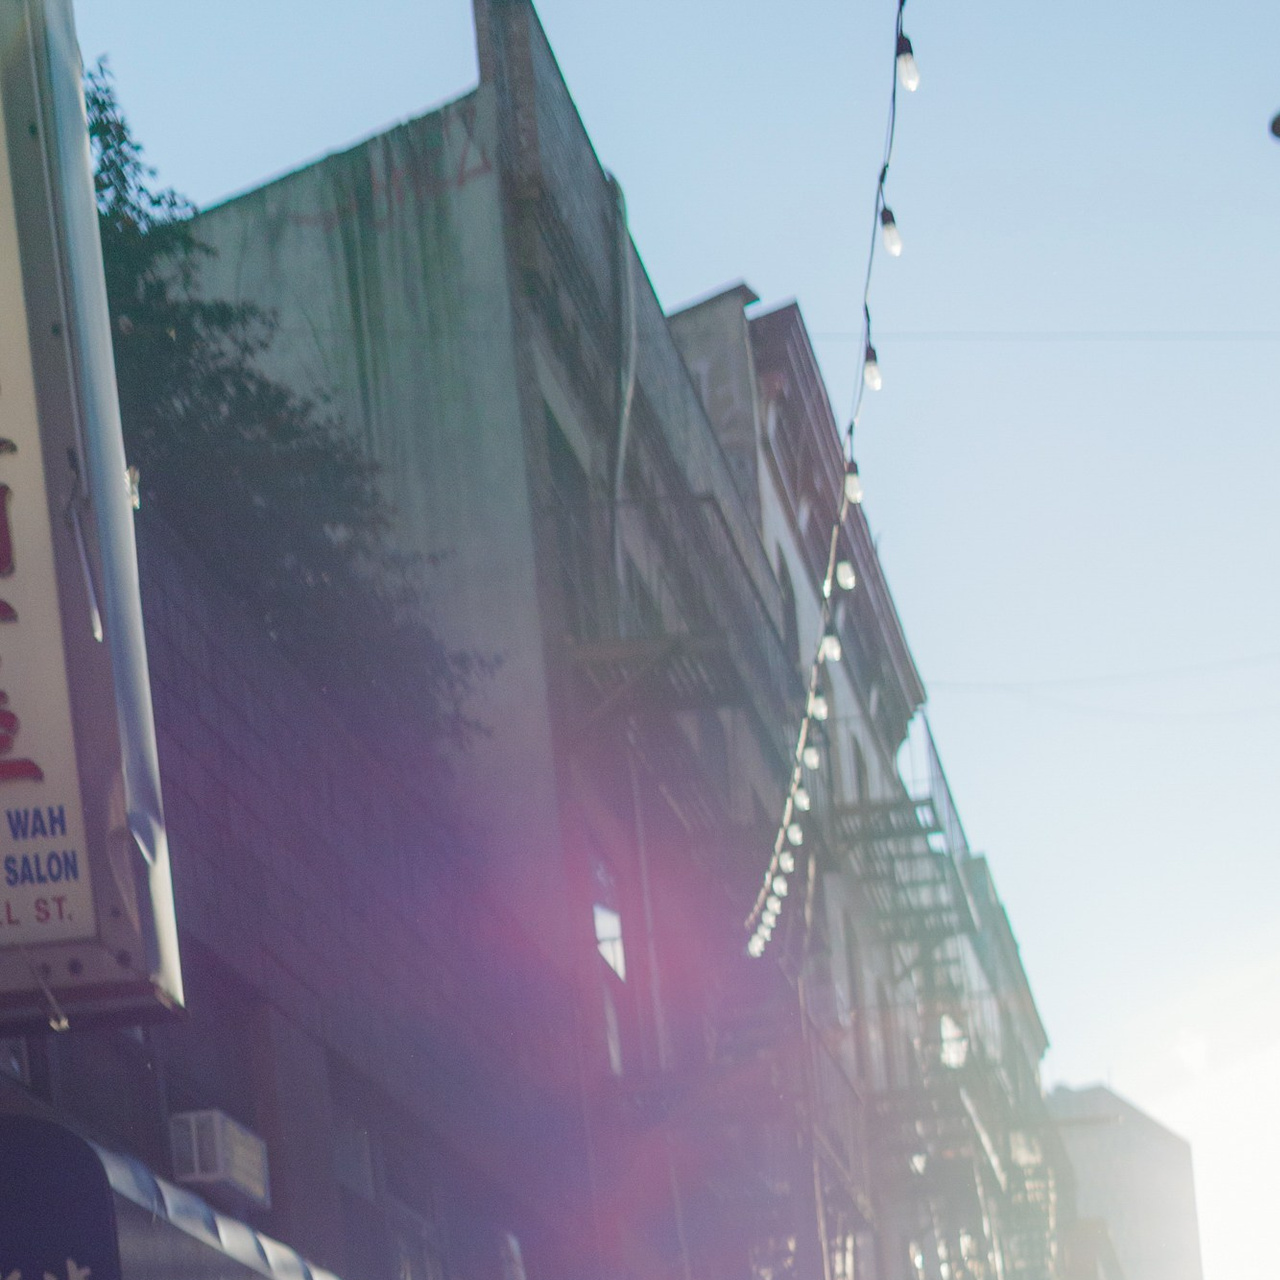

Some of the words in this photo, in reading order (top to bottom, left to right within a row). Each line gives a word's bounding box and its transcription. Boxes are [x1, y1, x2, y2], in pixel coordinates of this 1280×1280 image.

[5, 804, 67, 841] WAH
[3, 849, 79, 887] SALON
[34, 895, 74, 924] ST.
